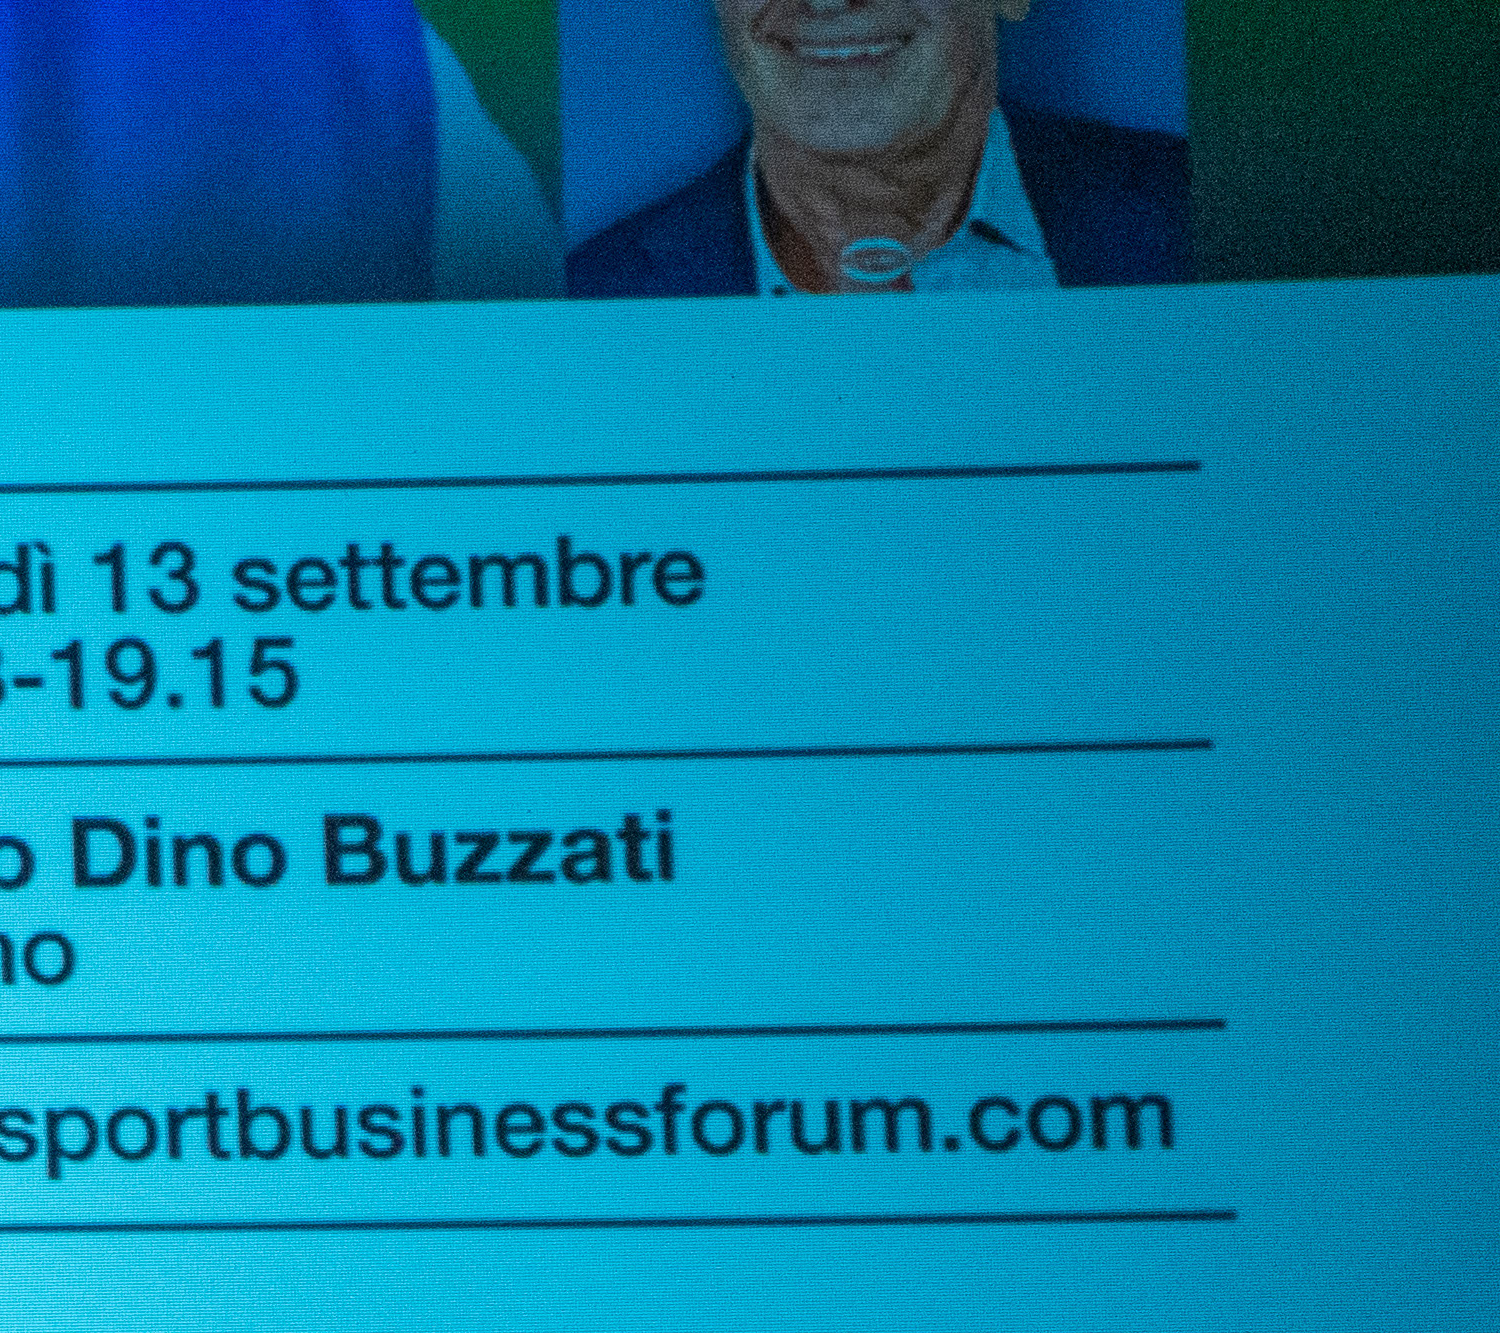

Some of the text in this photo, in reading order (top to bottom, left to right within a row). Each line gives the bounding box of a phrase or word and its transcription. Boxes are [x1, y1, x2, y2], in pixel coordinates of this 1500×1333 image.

[93, 541, 201, 614] 13
[232, 535, 707, 613] settembre
[71, 816, 288, 889] Dino
[323, 809, 675, 887] Buzzati
